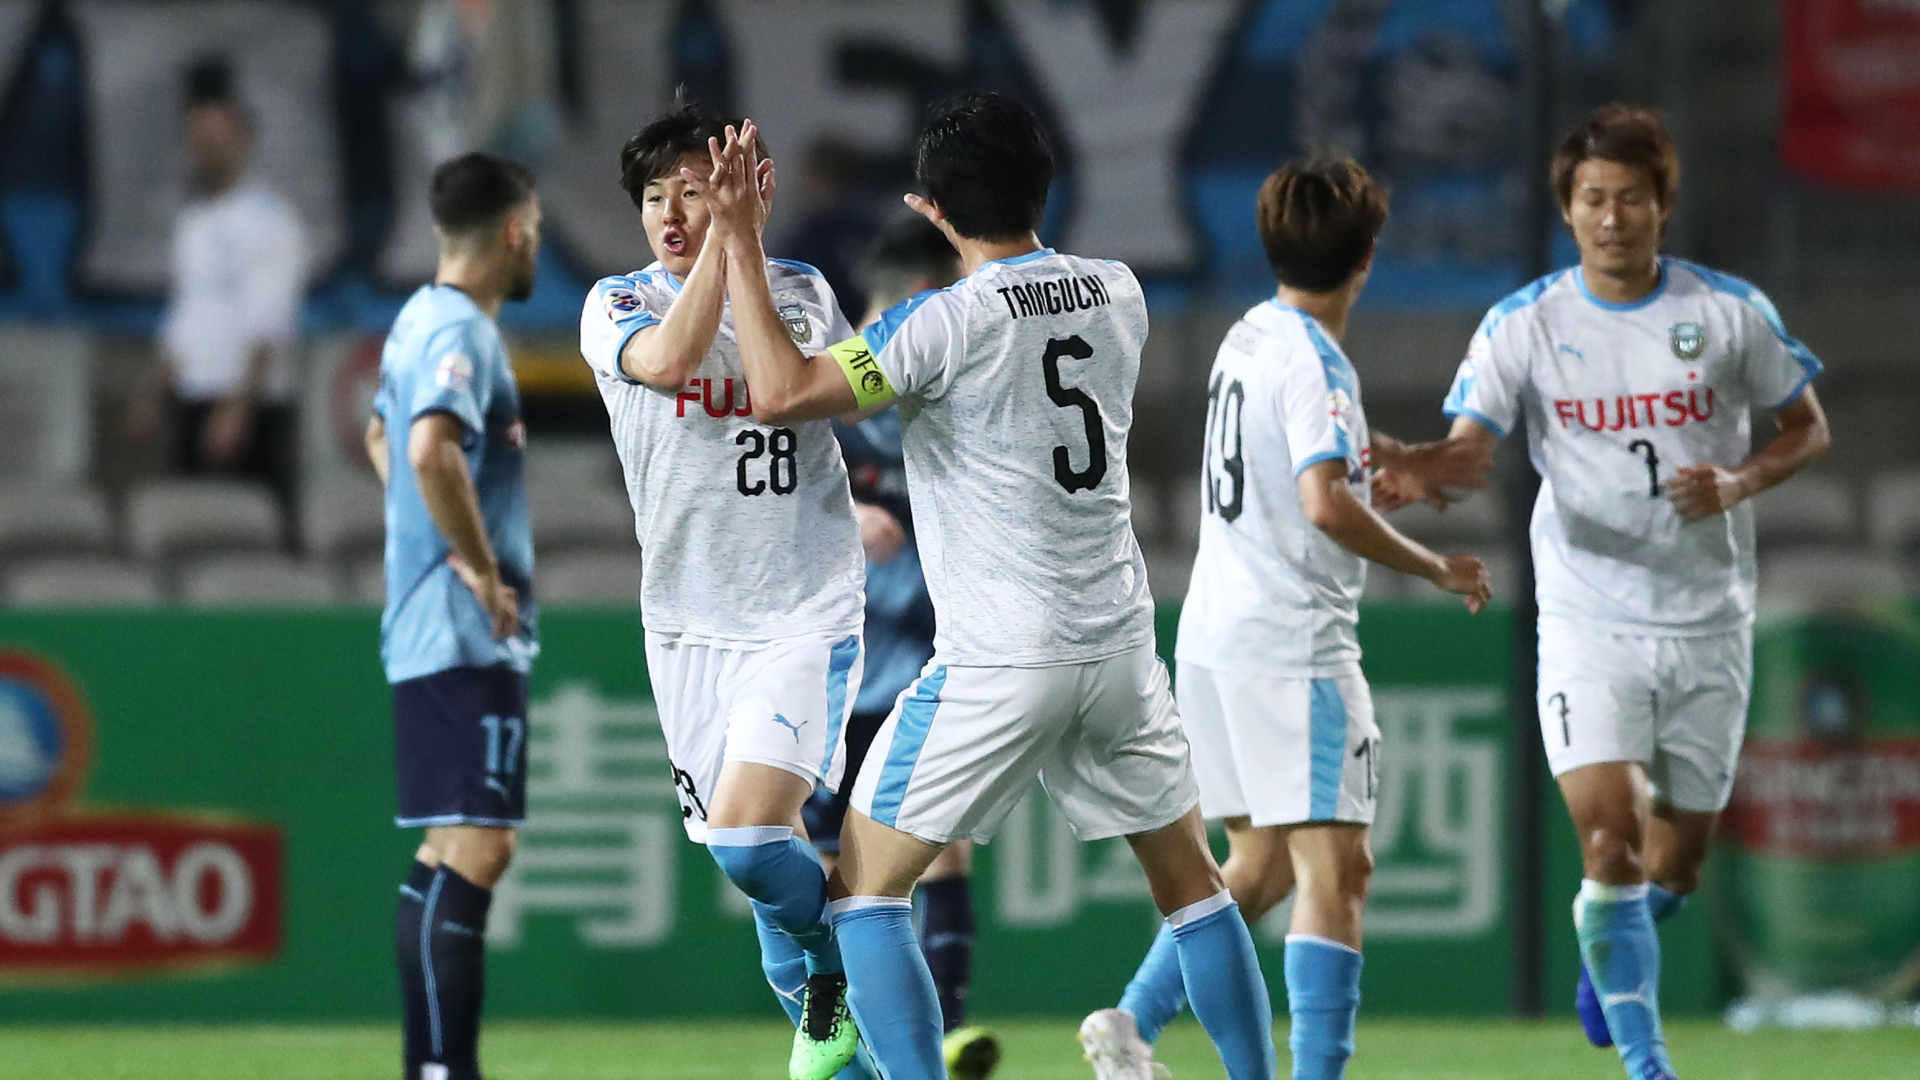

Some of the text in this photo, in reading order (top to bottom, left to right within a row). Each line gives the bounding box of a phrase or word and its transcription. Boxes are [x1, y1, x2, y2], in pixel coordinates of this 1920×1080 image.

[1042, 334, 1107, 494] 5
[1553, 386, 1716, 432] FUJITSU
[735, 428, 799, 497] 28
[1207, 370, 1246, 524] 19
[1627, 438, 1660, 497] 7
[480, 714, 523, 776] 17
[1547, 690, 1571, 748] 7
[0, 842, 254, 944] GTAO
